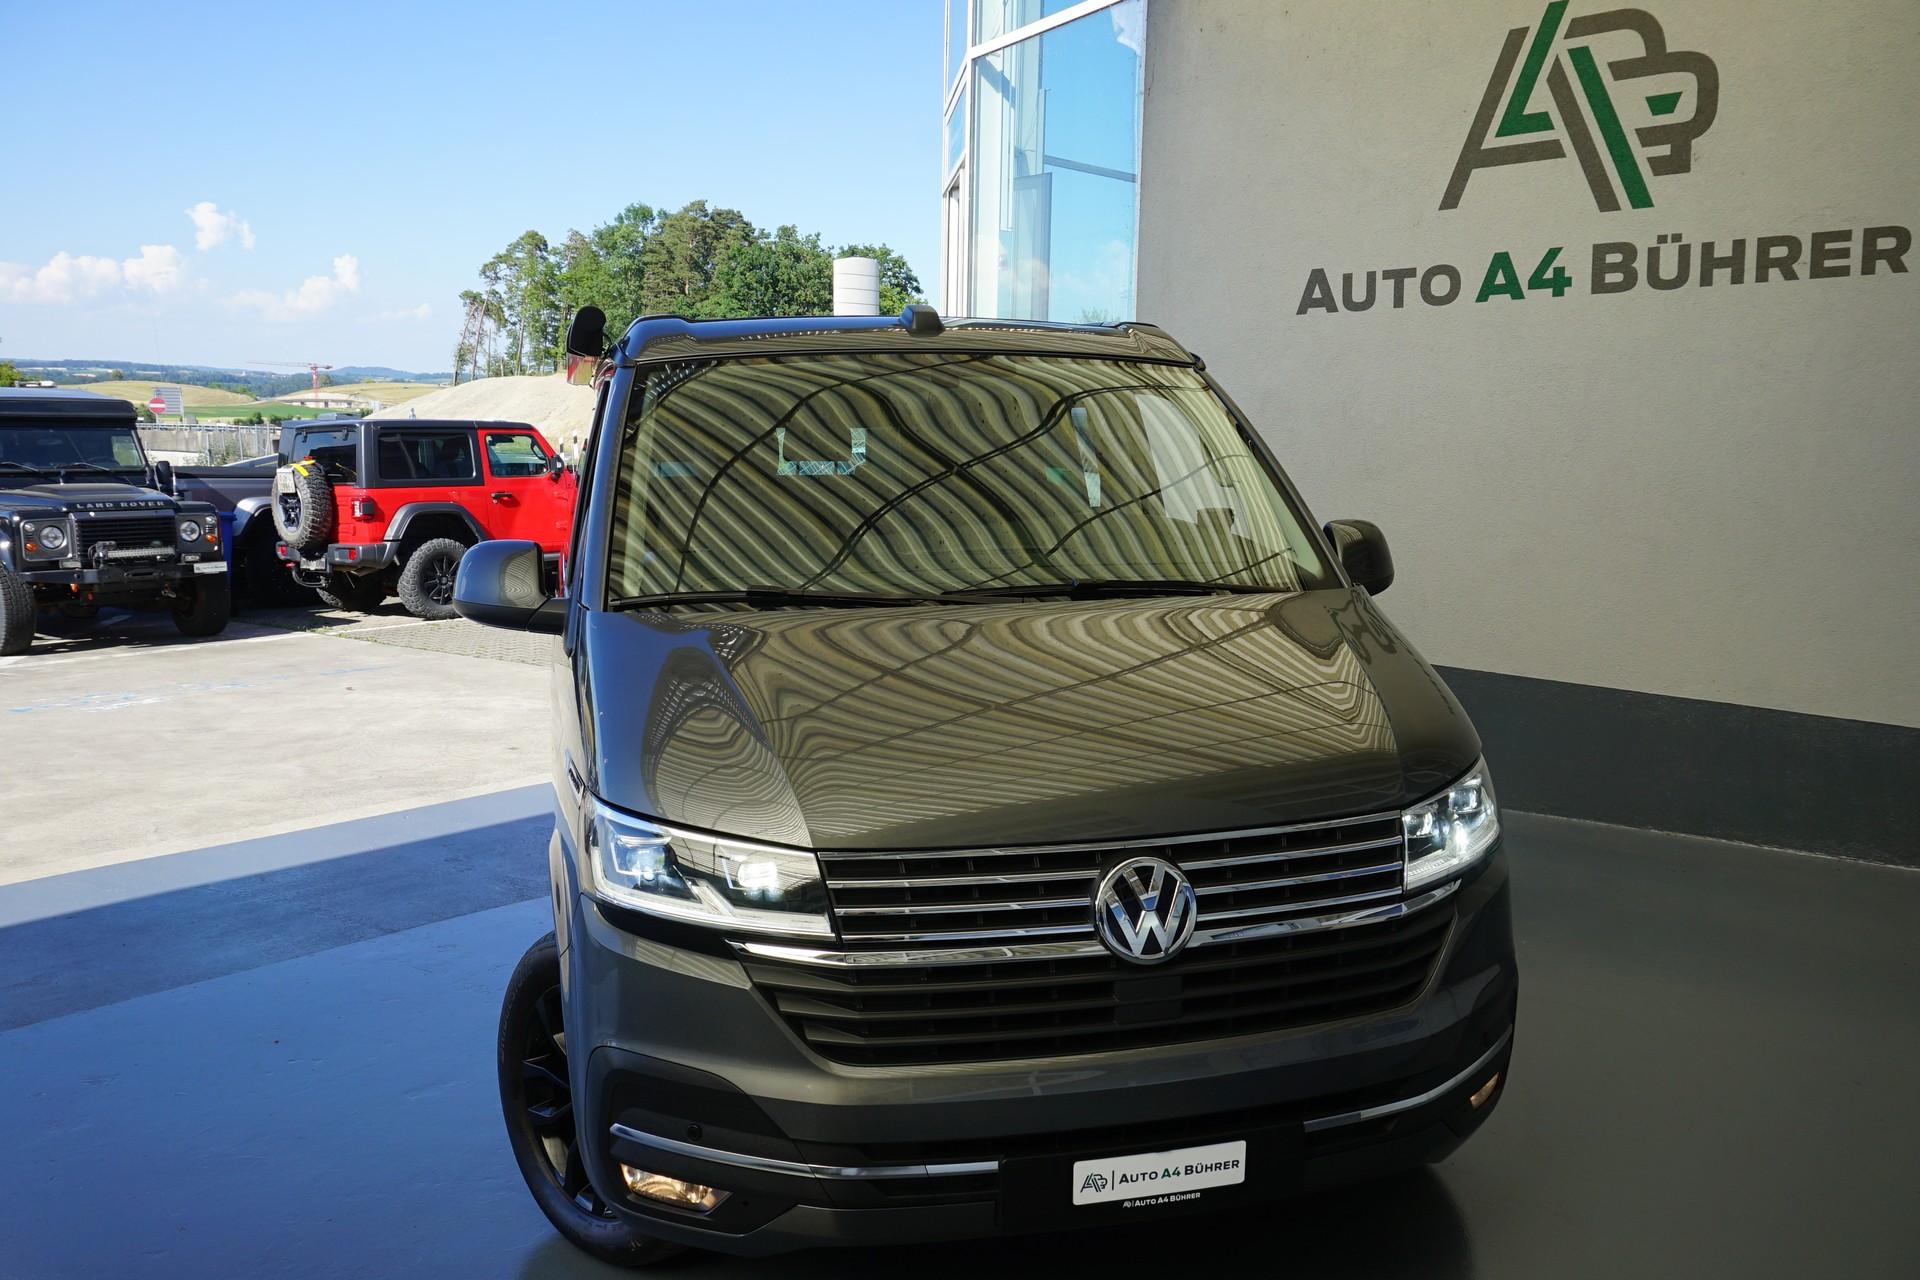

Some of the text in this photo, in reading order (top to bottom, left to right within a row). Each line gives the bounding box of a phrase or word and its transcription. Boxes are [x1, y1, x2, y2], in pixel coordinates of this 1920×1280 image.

[1296, 225, 1913, 315] AUTO A4 BÜHRER
[1103, 862, 1188, 958] VW
[1118, 1171, 1159, 1185] AUTO
[1161, 1166, 1181, 1179] A4
[1184, 1159, 1240, 1176] BÜHRER
[1134, 1198, 1157, 1207] AUTO
[1157, 1195, 1169, 1204] A4
[1170, 1192, 1201, 1202] BÜHRER
